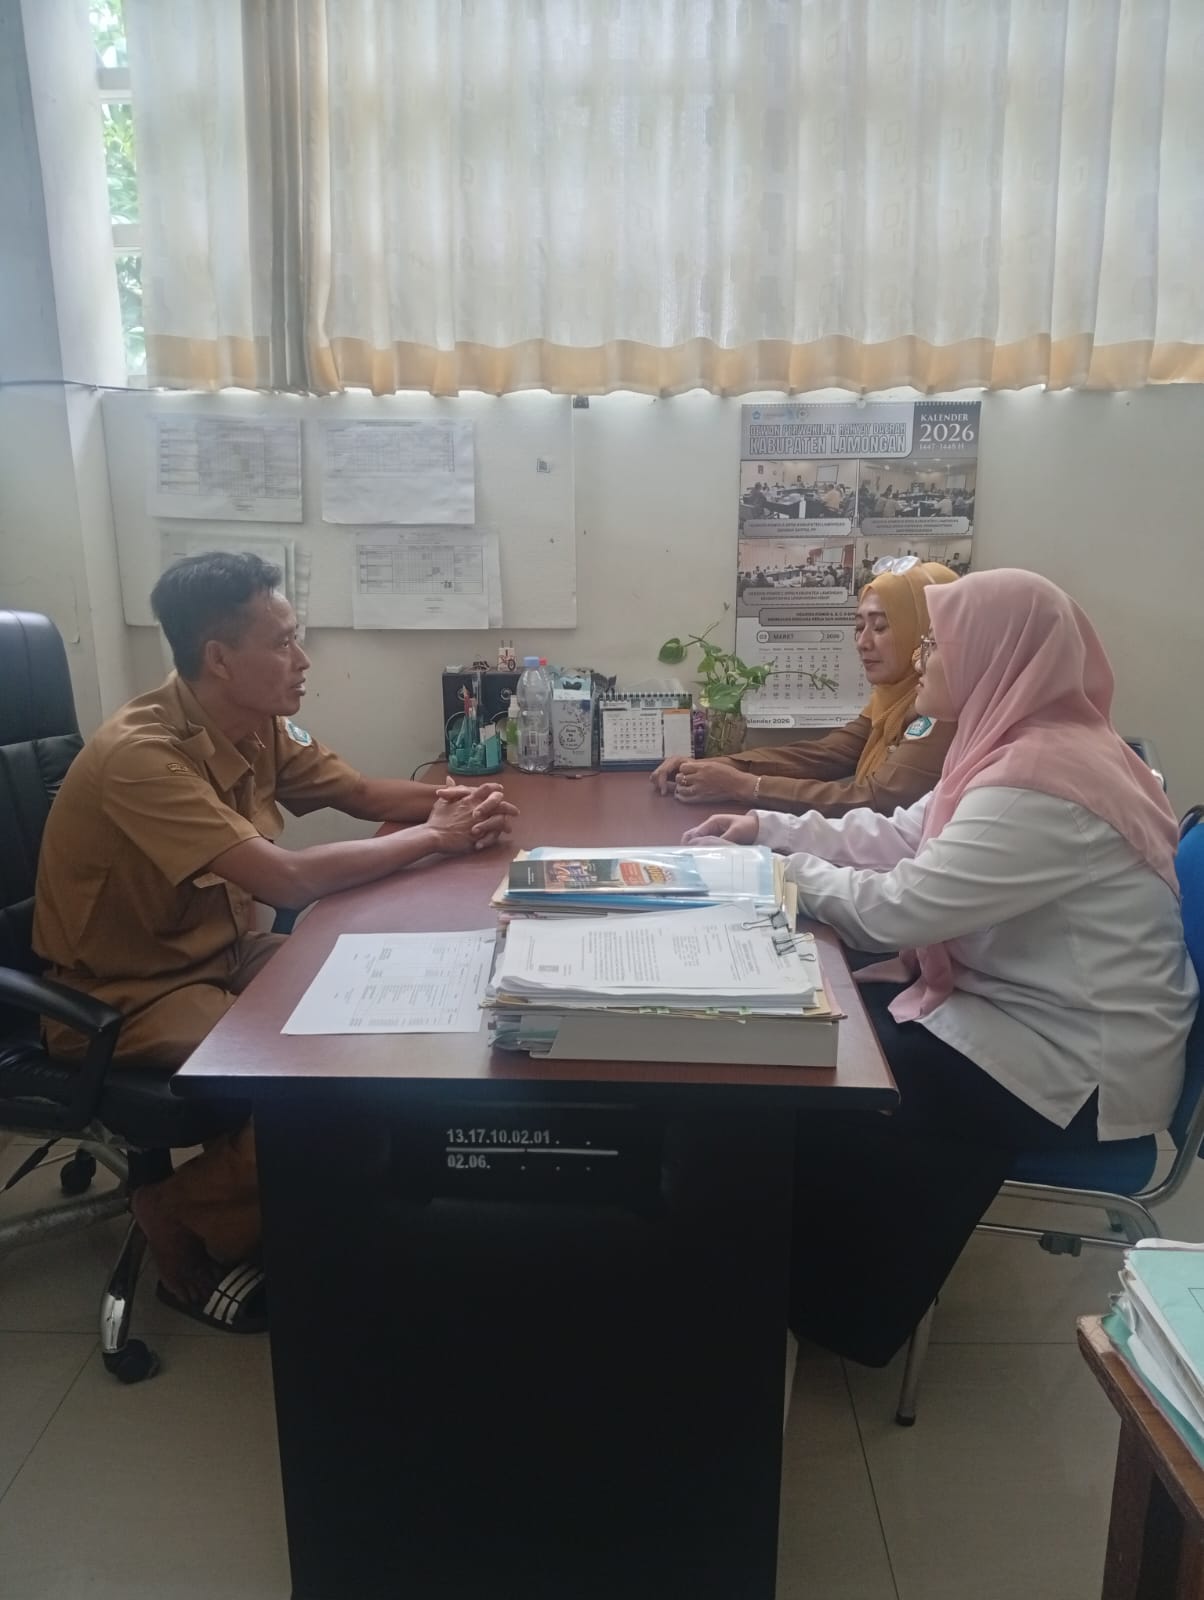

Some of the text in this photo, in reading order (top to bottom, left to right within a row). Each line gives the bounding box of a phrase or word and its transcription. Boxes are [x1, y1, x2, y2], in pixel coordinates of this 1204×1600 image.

[920, 413, 969, 422] KALENDER
[749, 424, 781, 436] DEWAN
[919, 423, 975, 442] 2026
[749, 435, 907, 455] KABUPATEN LAMONGAN
[446, 1128, 550, 1144] 13.17.10.02.01
